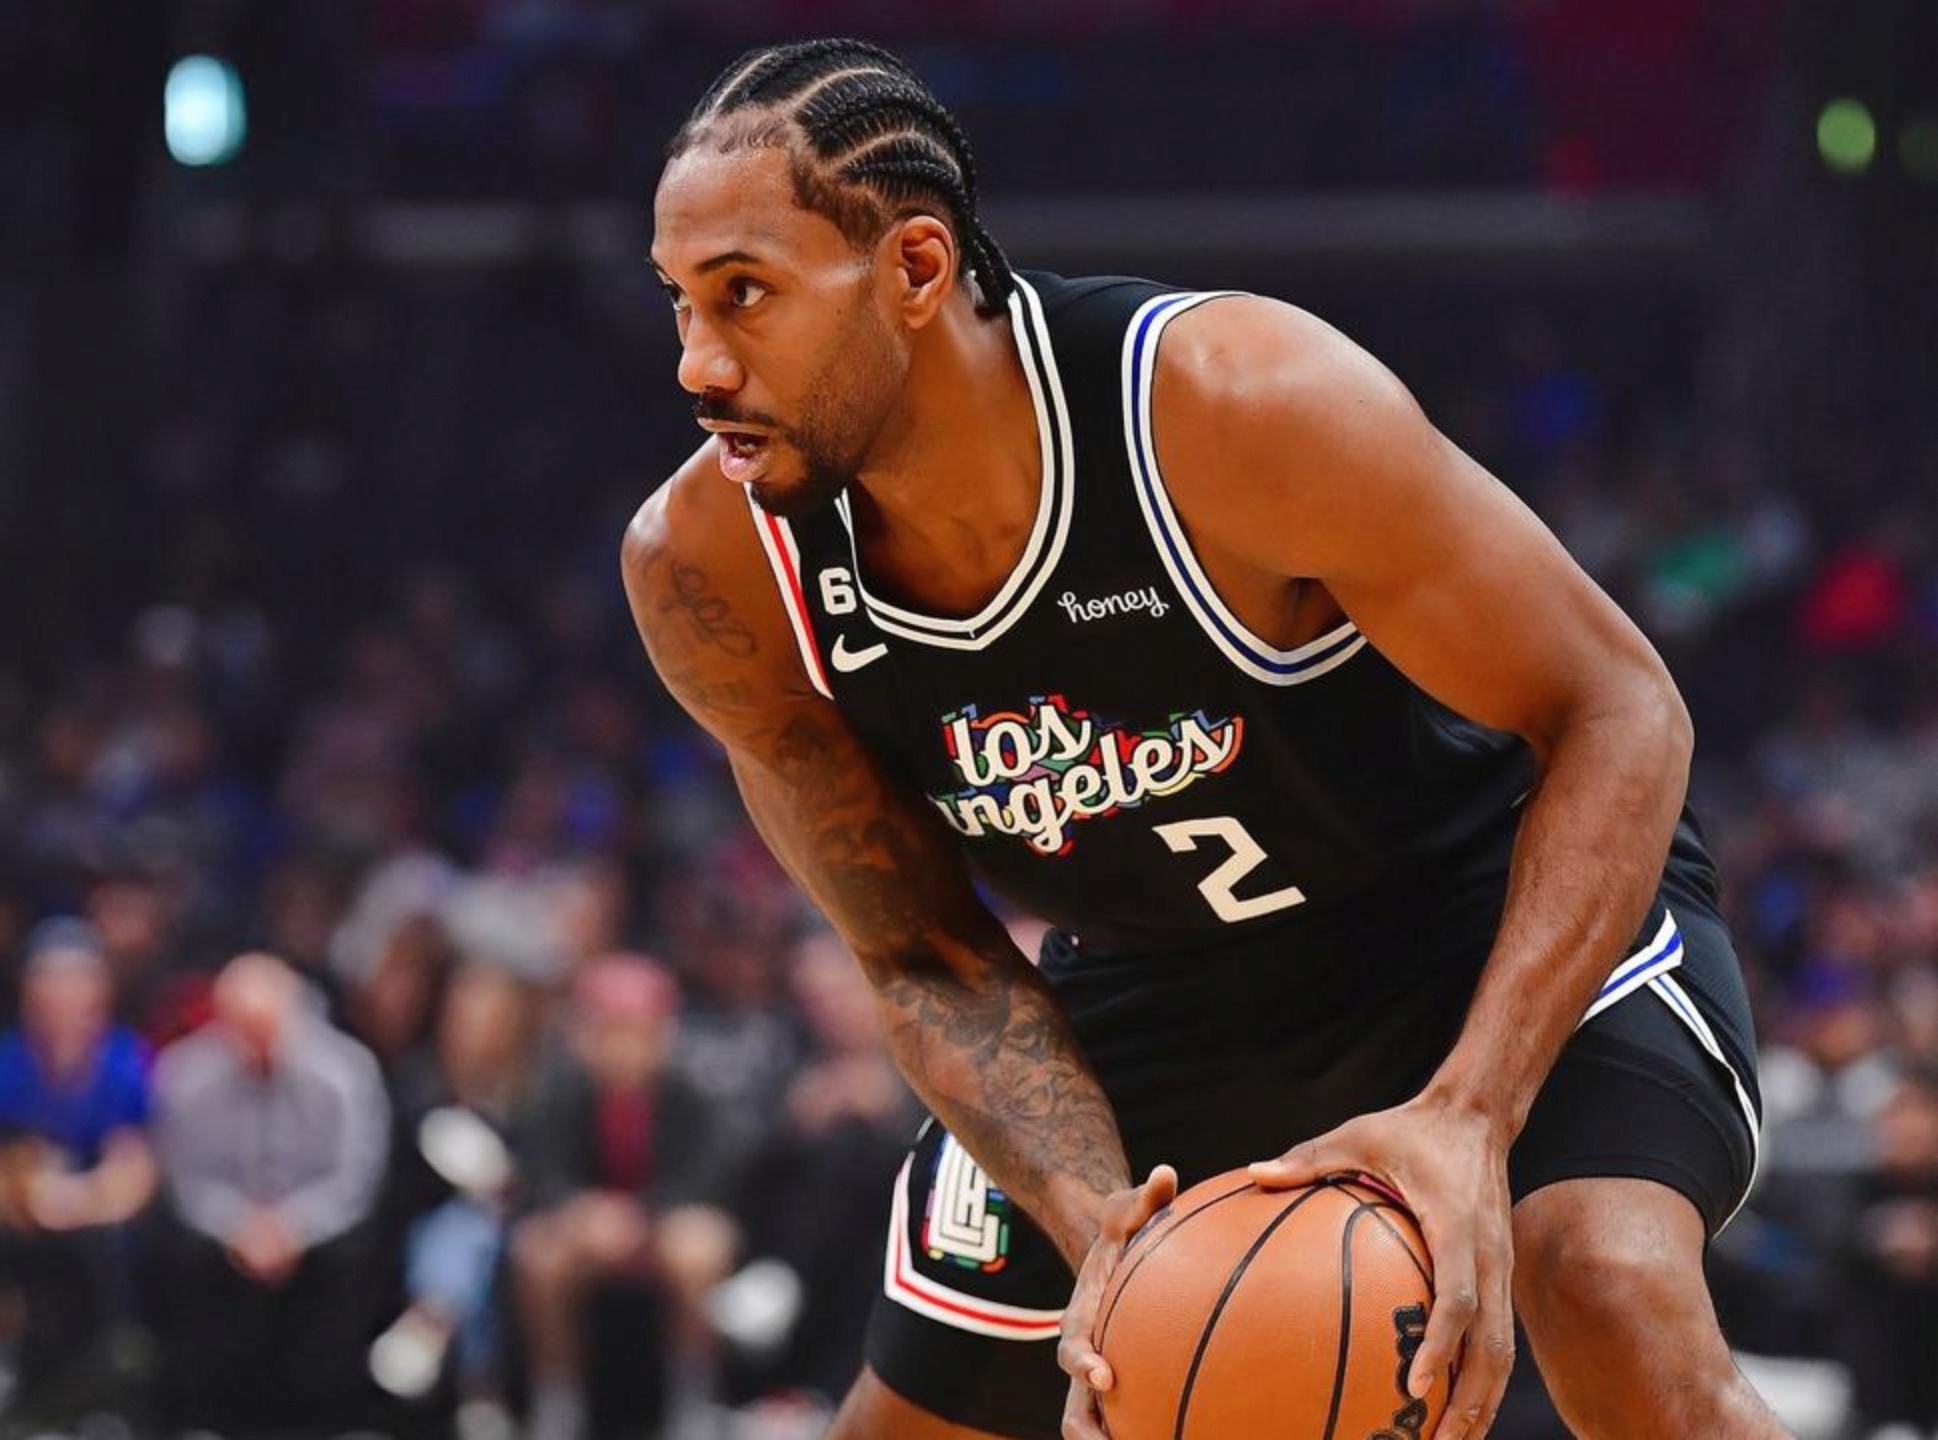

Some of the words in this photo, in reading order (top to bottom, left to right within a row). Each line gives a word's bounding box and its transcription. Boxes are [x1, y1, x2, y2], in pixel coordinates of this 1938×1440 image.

[818, 567, 857, 615] 6
[1057, 586, 1170, 623] honey
[1152, 816, 1307, 923] 2
